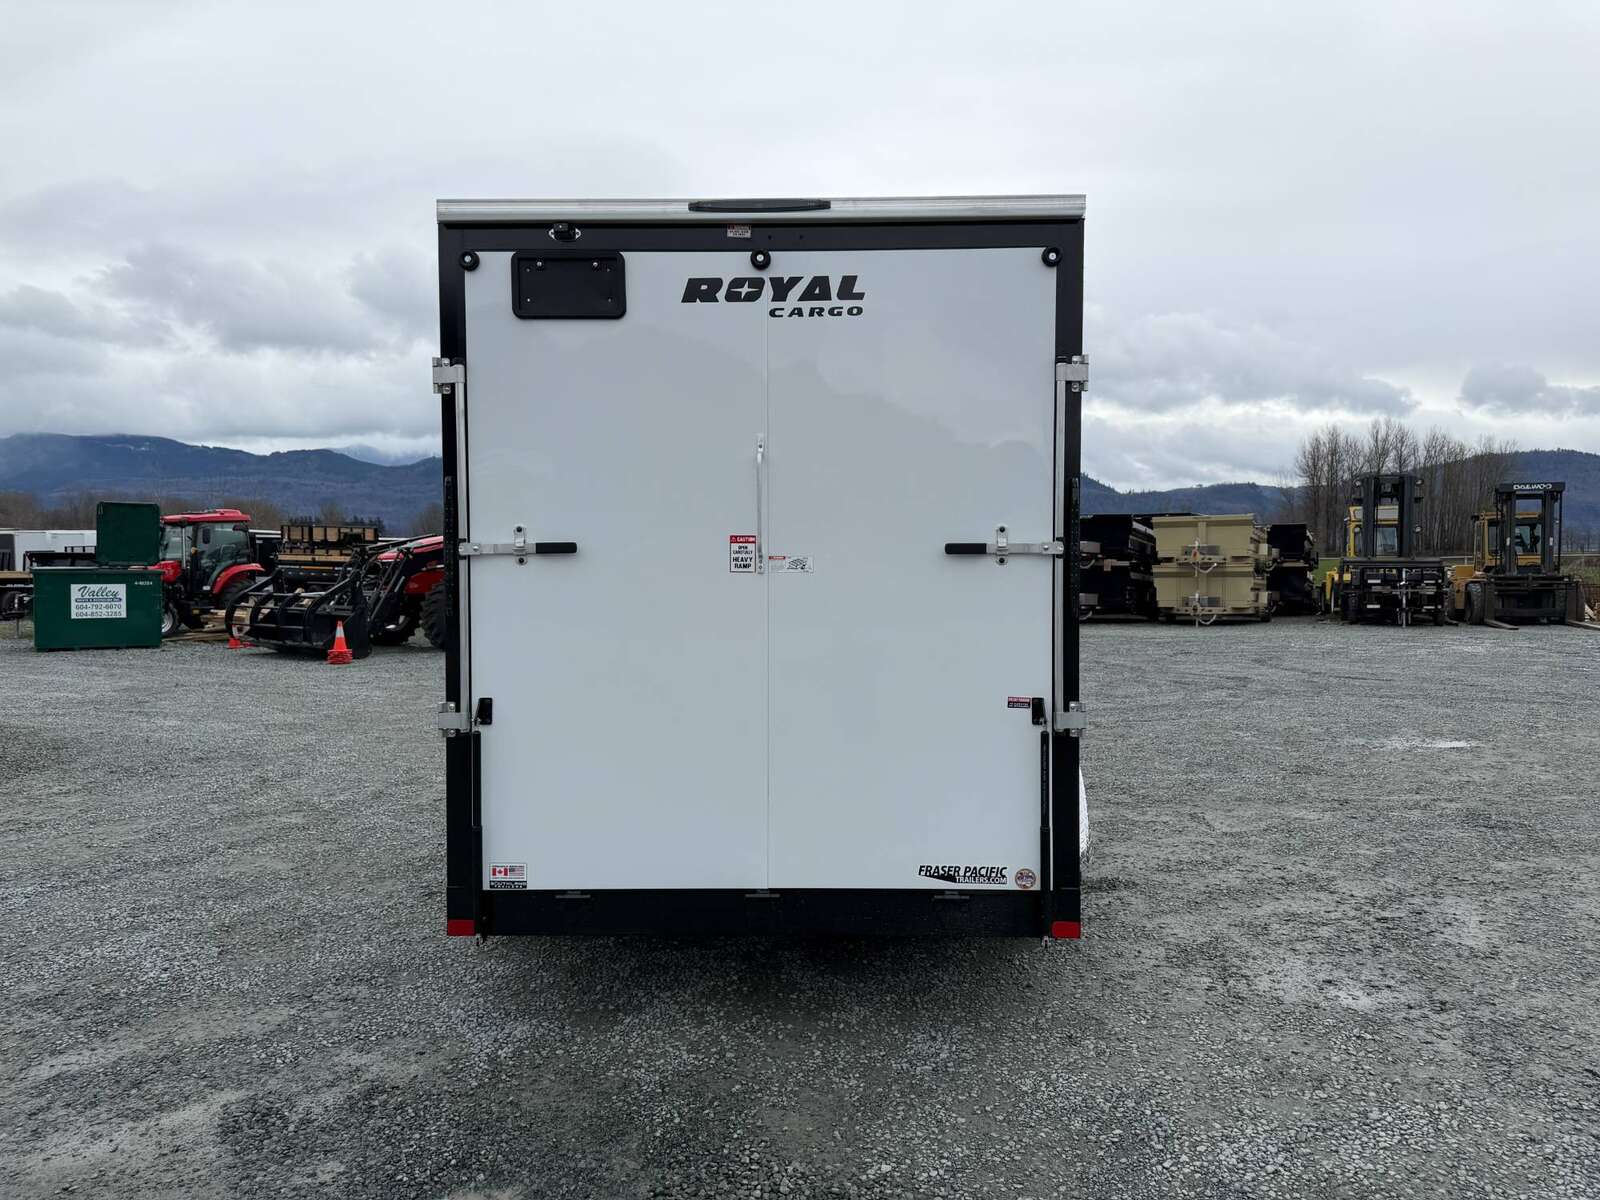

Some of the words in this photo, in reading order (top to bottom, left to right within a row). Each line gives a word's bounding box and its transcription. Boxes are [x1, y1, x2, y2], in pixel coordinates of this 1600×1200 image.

[681, 275, 866, 303] ROYAL
[768, 306, 864, 318] CARGO
[78, 585, 120, 598] Valley
[918, 865, 961, 877] FRASER
[963, 866, 1008, 878] PACIFIC
[956, 876, 1008, 885] TRAILERS.COM
